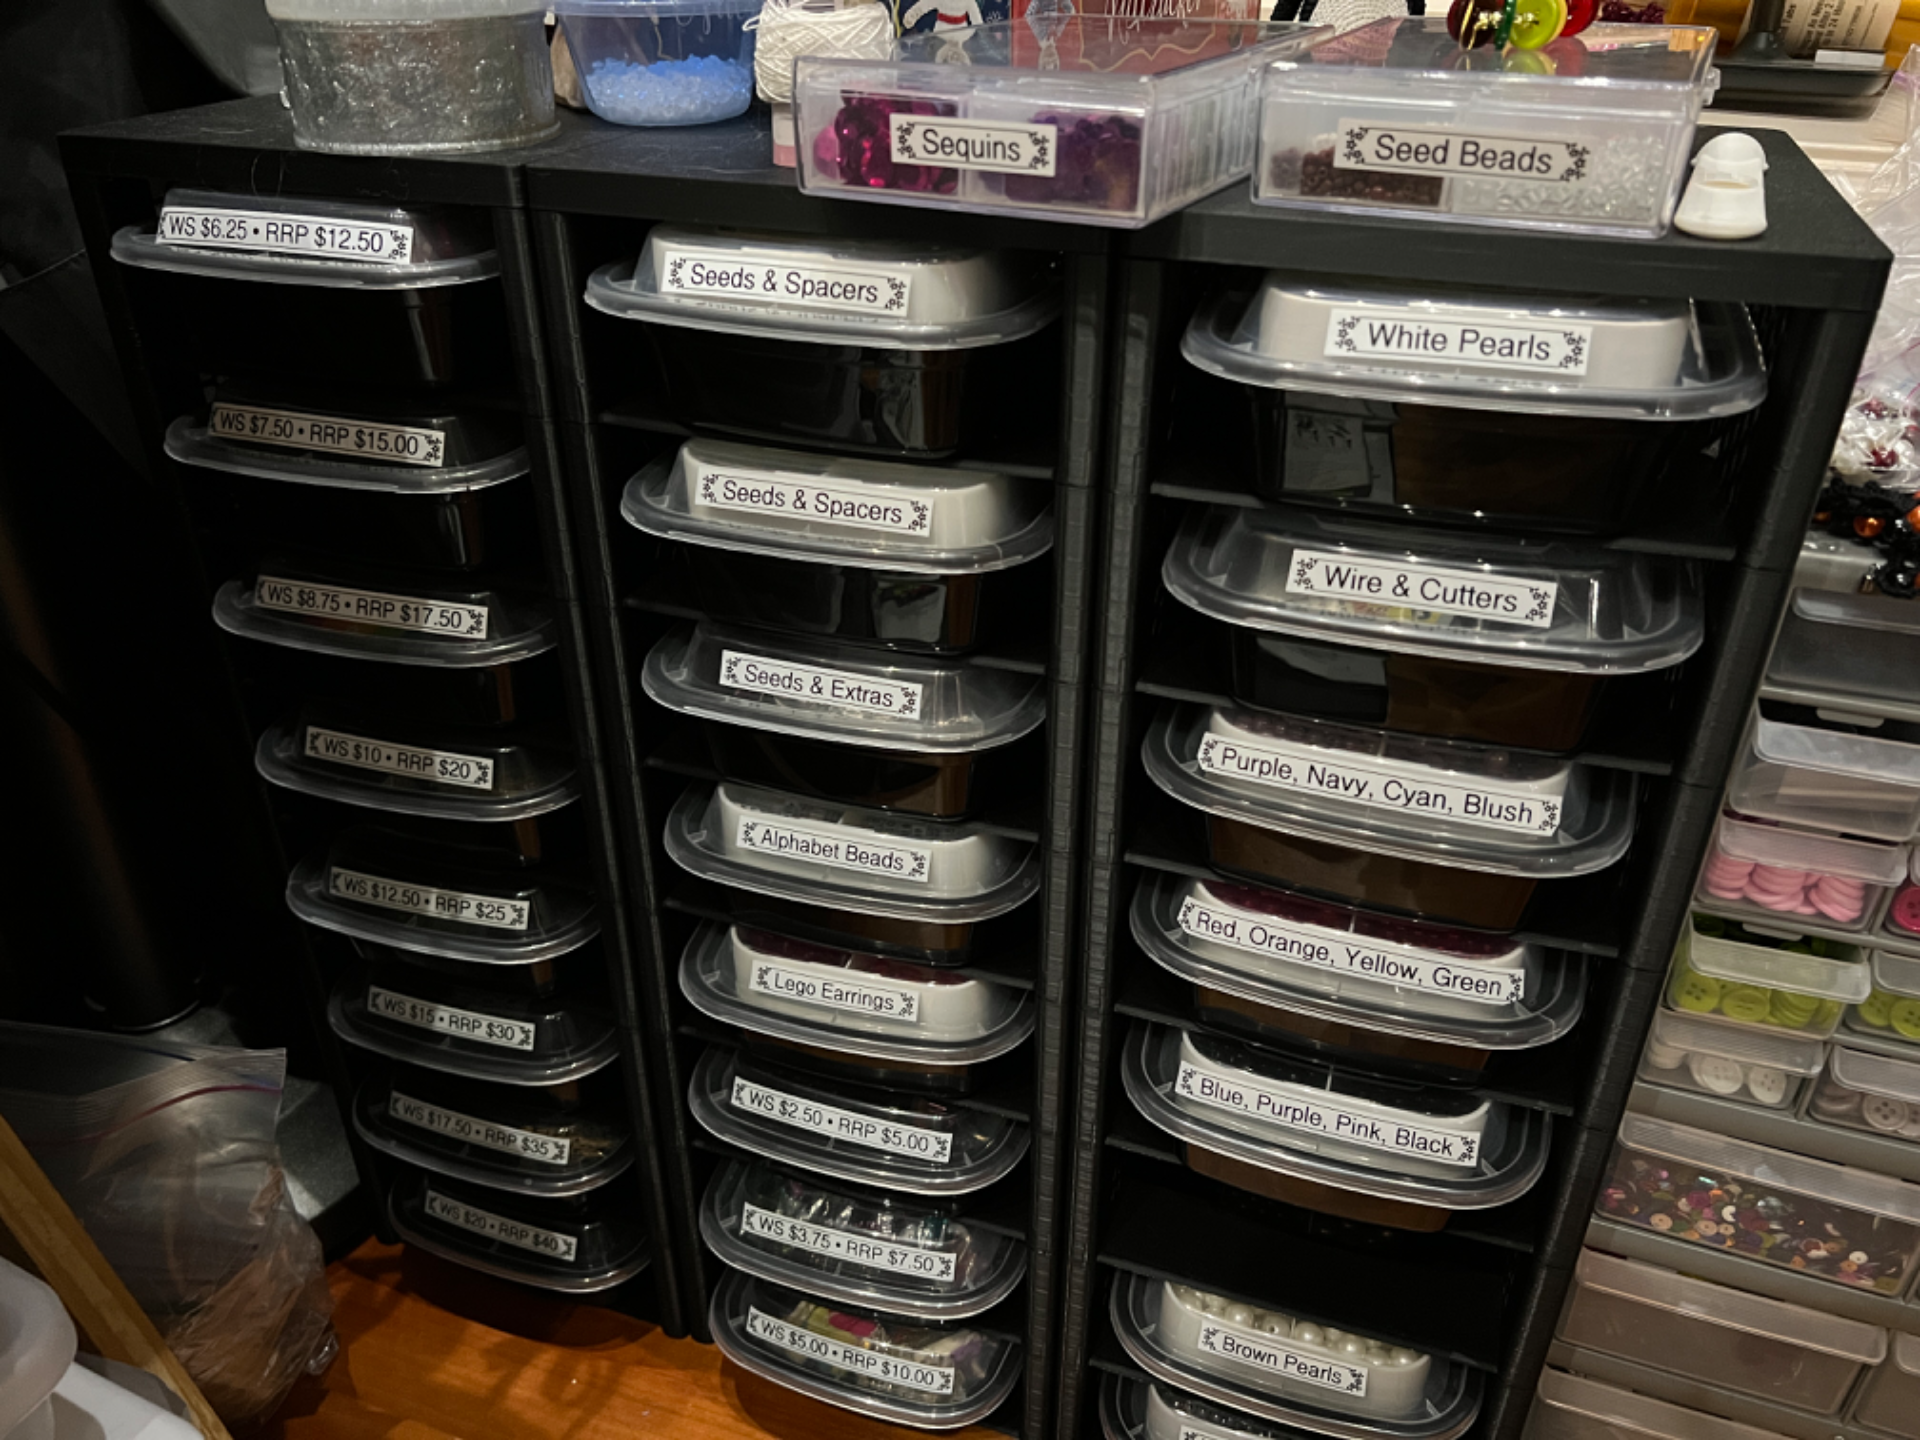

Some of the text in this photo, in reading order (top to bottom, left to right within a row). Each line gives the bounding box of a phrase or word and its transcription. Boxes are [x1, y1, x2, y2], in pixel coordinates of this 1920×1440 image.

[922, 128, 1021, 163] Sequins
[1375, 134, 1553, 174] Seed Beads
[169, 216, 383, 253] WS $6.25 RRP $12.50
[690, 263, 878, 303] Seeds & Spacers
[1368, 322, 1551, 361] White Pearls
[220, 411, 419, 456] WS $7.50 RRP $15.00
[723, 479, 902, 524] Seeds & Spacers
[268, 584, 462, 629] WS $8.75 RRP $17.50
[1325, 565, 1382, 593] Wire
[1391, 573, 1410, 598] &
[1420, 577, 1518, 613] Cutters
[744, 663, 893, 708] Seeds & Extras
[323, 736, 470, 780] WS $10 RRP $20
[1220, 746, 1533, 825] Purple, Navy, Cyan, Blush
[760, 828, 904, 872] Alphabet Beads
[344, 876, 506, 921] WS $12.50 RRP $25
[1195, 910, 1502, 997] Red, Orange, Yellow, Green
[774, 972, 895, 1011] Lego Earrings
[384, 996, 515, 1041] WS $15 RRP $30
[403, 1102, 549, 1156] WS $17.50 RRP $35
[750, 1090, 929, 1153] WS $2.50 RRP $5.00
[1200, 1078, 1454, 1157] Blue, Purple, Pink, Black
[441, 1201, 559, 1251] WS $20 RRP $40
[759, 1216, 934, 1273] WS $3.75 RRP $7.50
[761, 1319, 935, 1386] WS $5.00 RRP $10.00
[1222, 1335, 1342, 1385] Brown Pearls
